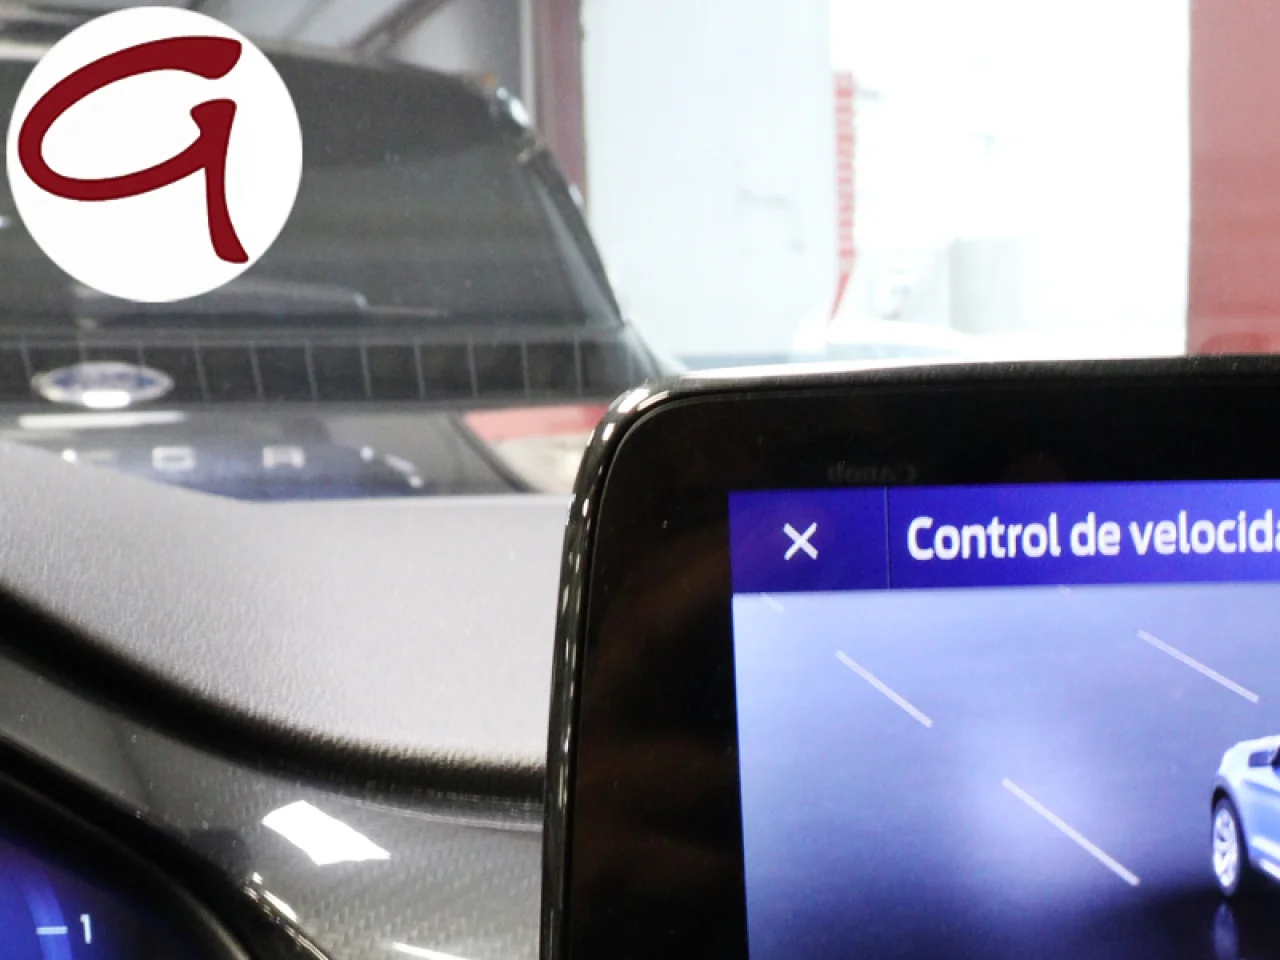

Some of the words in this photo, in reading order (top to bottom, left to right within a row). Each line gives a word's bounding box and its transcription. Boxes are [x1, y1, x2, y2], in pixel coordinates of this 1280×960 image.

[907, 512, 1062, 561] Control
[1069, 511, 1121, 557] de
[79, 913, 93, 945] 1
